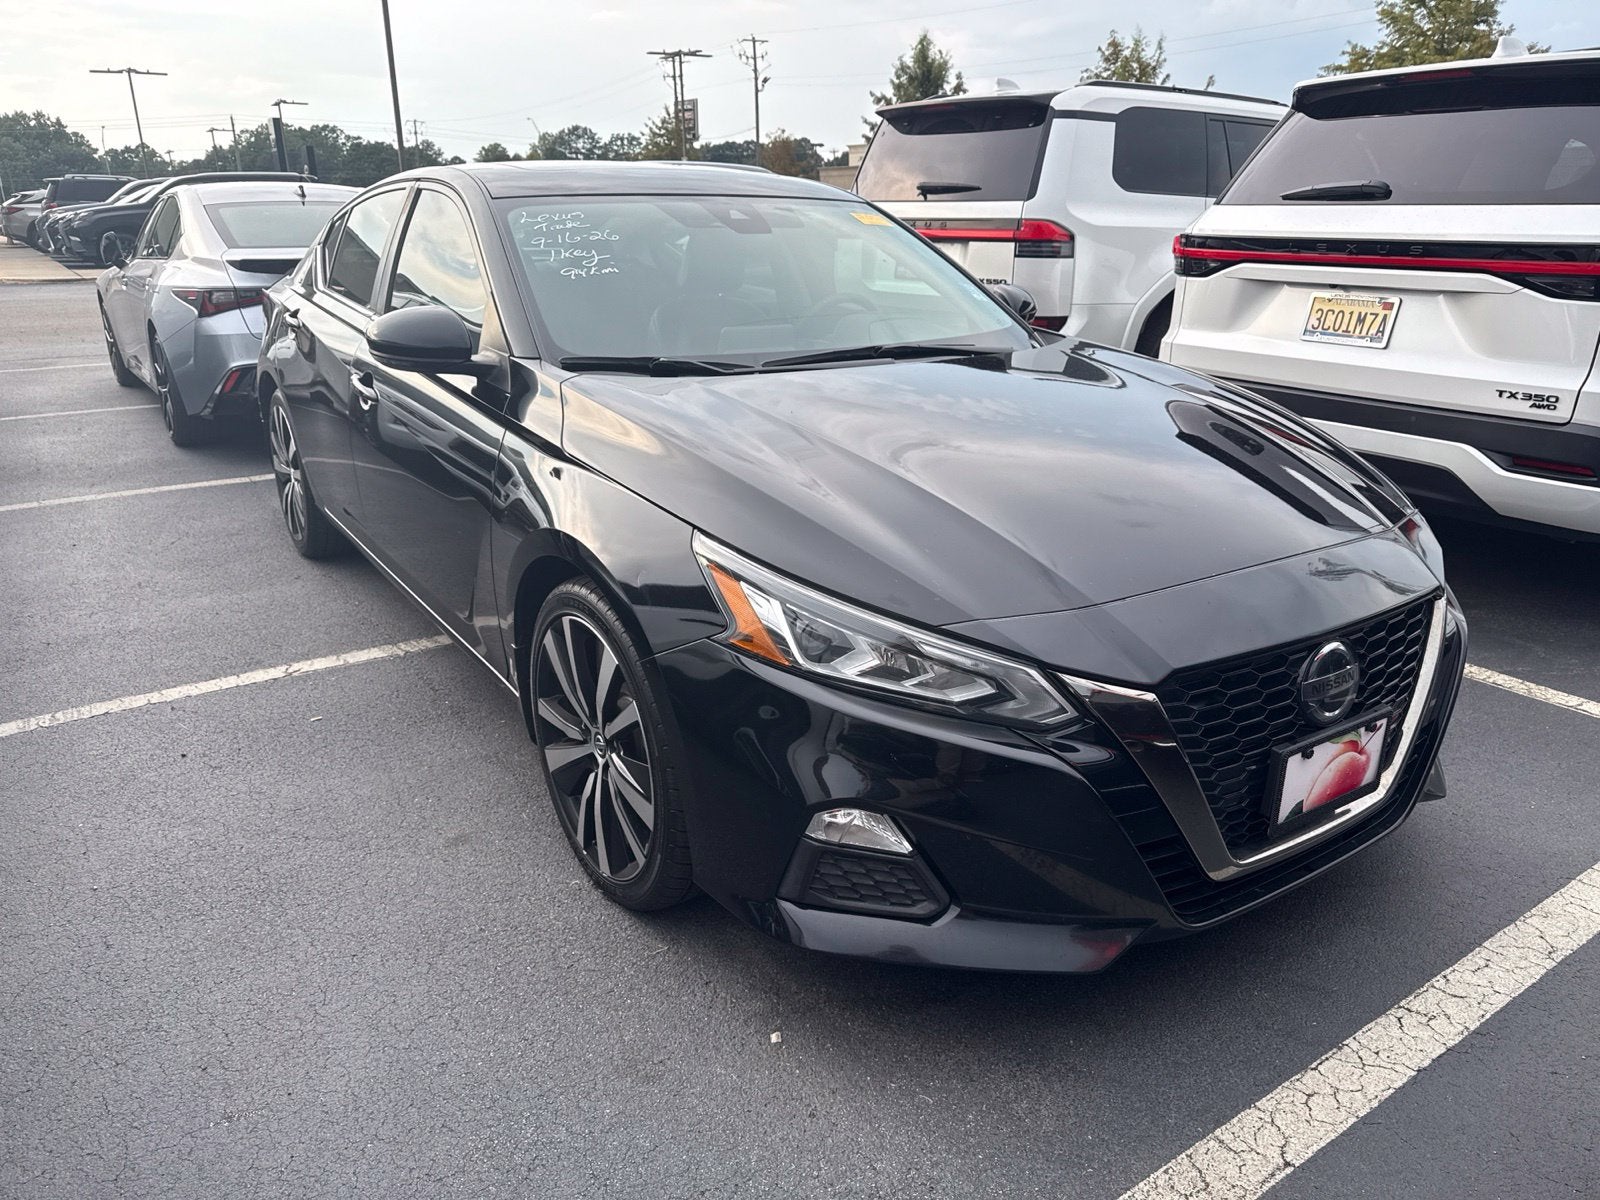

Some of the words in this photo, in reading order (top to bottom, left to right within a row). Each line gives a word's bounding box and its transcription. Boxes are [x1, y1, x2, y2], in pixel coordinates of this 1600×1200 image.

[531, 230, 620, 249] 9-16-26
[1287, 242, 1424, 256] LEXUS
[1311, 308, 1389, 338] 3C01M7A
[1528, 402, 1557, 411] AWD
[1311, 670, 1355, 696] NISSAN
